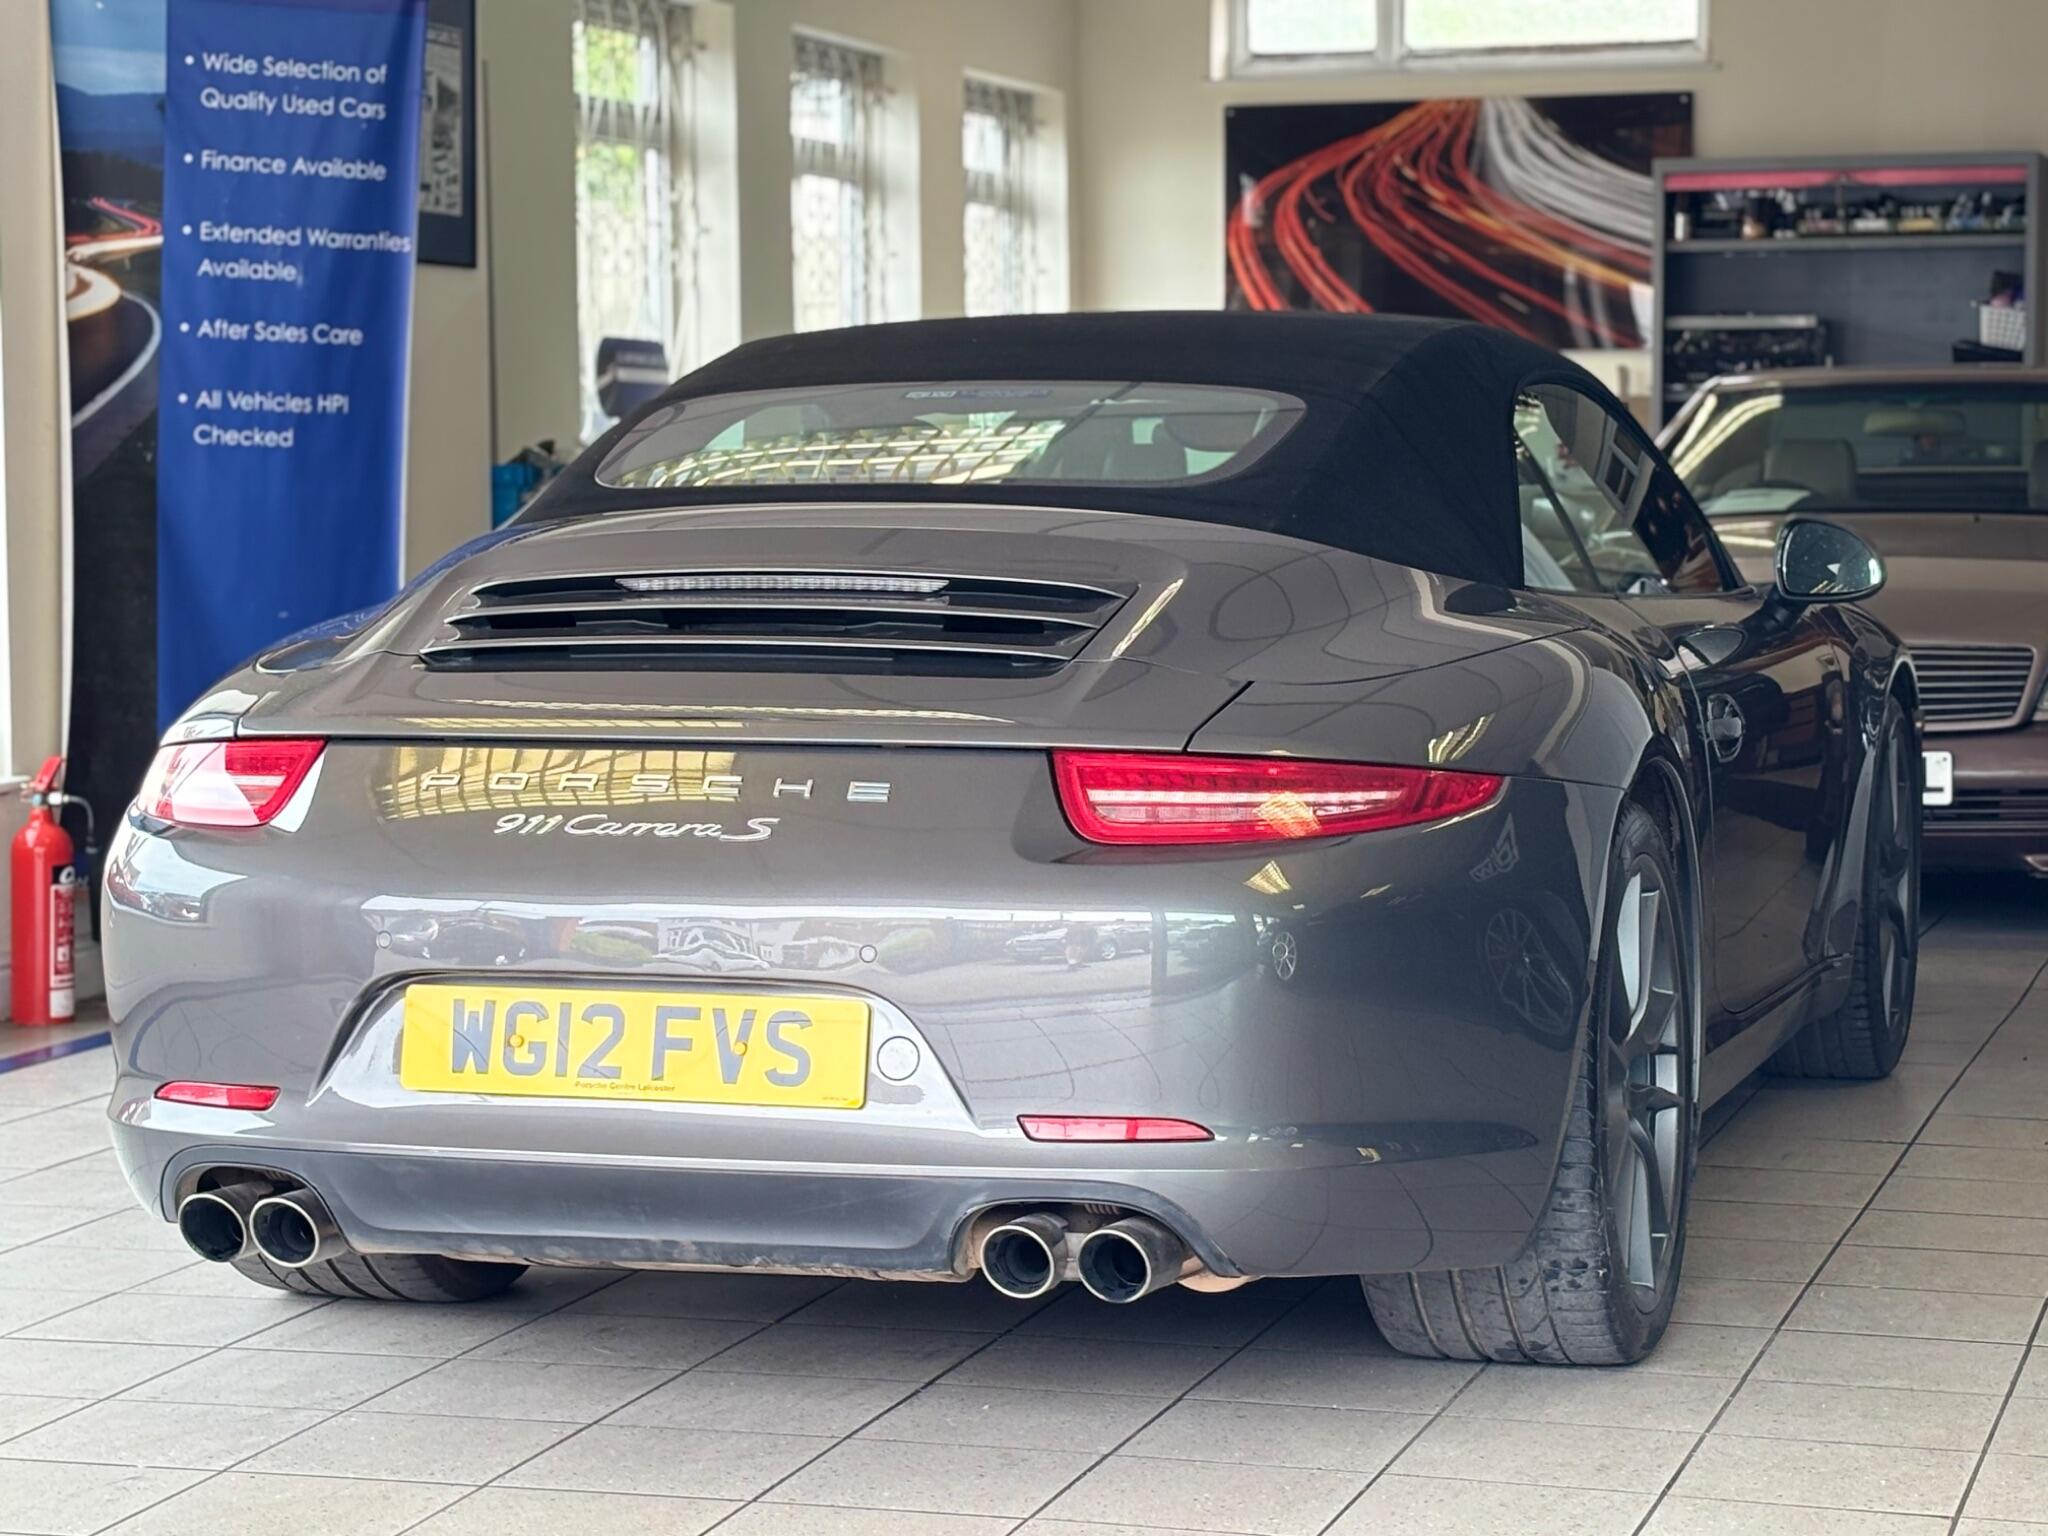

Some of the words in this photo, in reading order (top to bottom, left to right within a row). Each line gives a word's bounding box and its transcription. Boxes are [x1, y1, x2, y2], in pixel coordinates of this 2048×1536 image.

[203, 53, 258, 75] Wide
[263, 56, 360, 82] Selection
[365, 64, 387, 84] of
[200, 87, 277, 115] Quality
[282, 94, 334, 116] Used
[339, 98, 386, 120] Cars
[201, 150, 286, 174] Finance
[292, 157, 387, 181] Available
[200, 221, 301, 246] Extended
[306, 228, 412, 252] Warranties
[197, 319, 249, 340] After
[254, 321, 308, 343] Sales
[312, 324, 363, 345] Care
[195, 390, 222, 410] All
[227, 390, 312, 414] Vehicles
[316, 393, 349, 414] HPI
[193, 424, 294, 448] Checked
[421, 772, 892, 802] PORSCHE
[494, 814, 563, 835] 911
[564, 814, 722, 837] Carrera
[719, 817, 780, 841] S
[451, 998, 626, 1080] WG12
[651, 1005, 814, 1087] FVS
